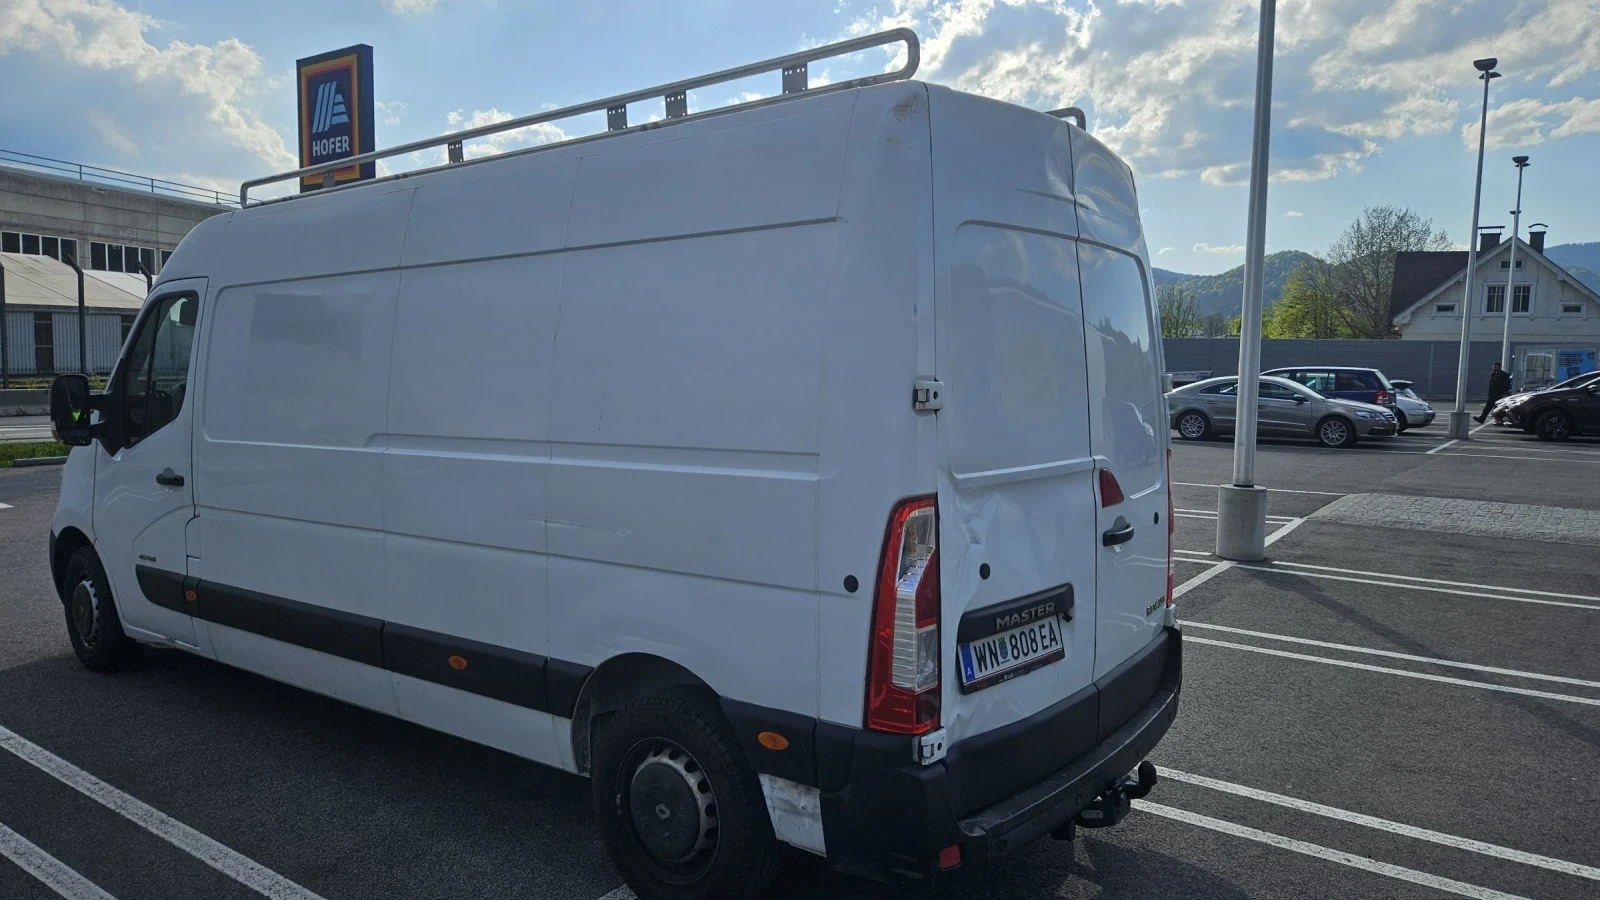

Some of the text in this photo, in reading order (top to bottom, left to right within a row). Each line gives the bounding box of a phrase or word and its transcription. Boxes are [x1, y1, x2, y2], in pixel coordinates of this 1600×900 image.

[312, 136, 350, 157] HOFER
[995, 602, 1055, 630] MASTER
[967, 667, 973, 676] A
[973, 638, 1000, 673] WN
[1009, 627, 1039, 661] 808
[1038, 620, 1058, 651] EA
